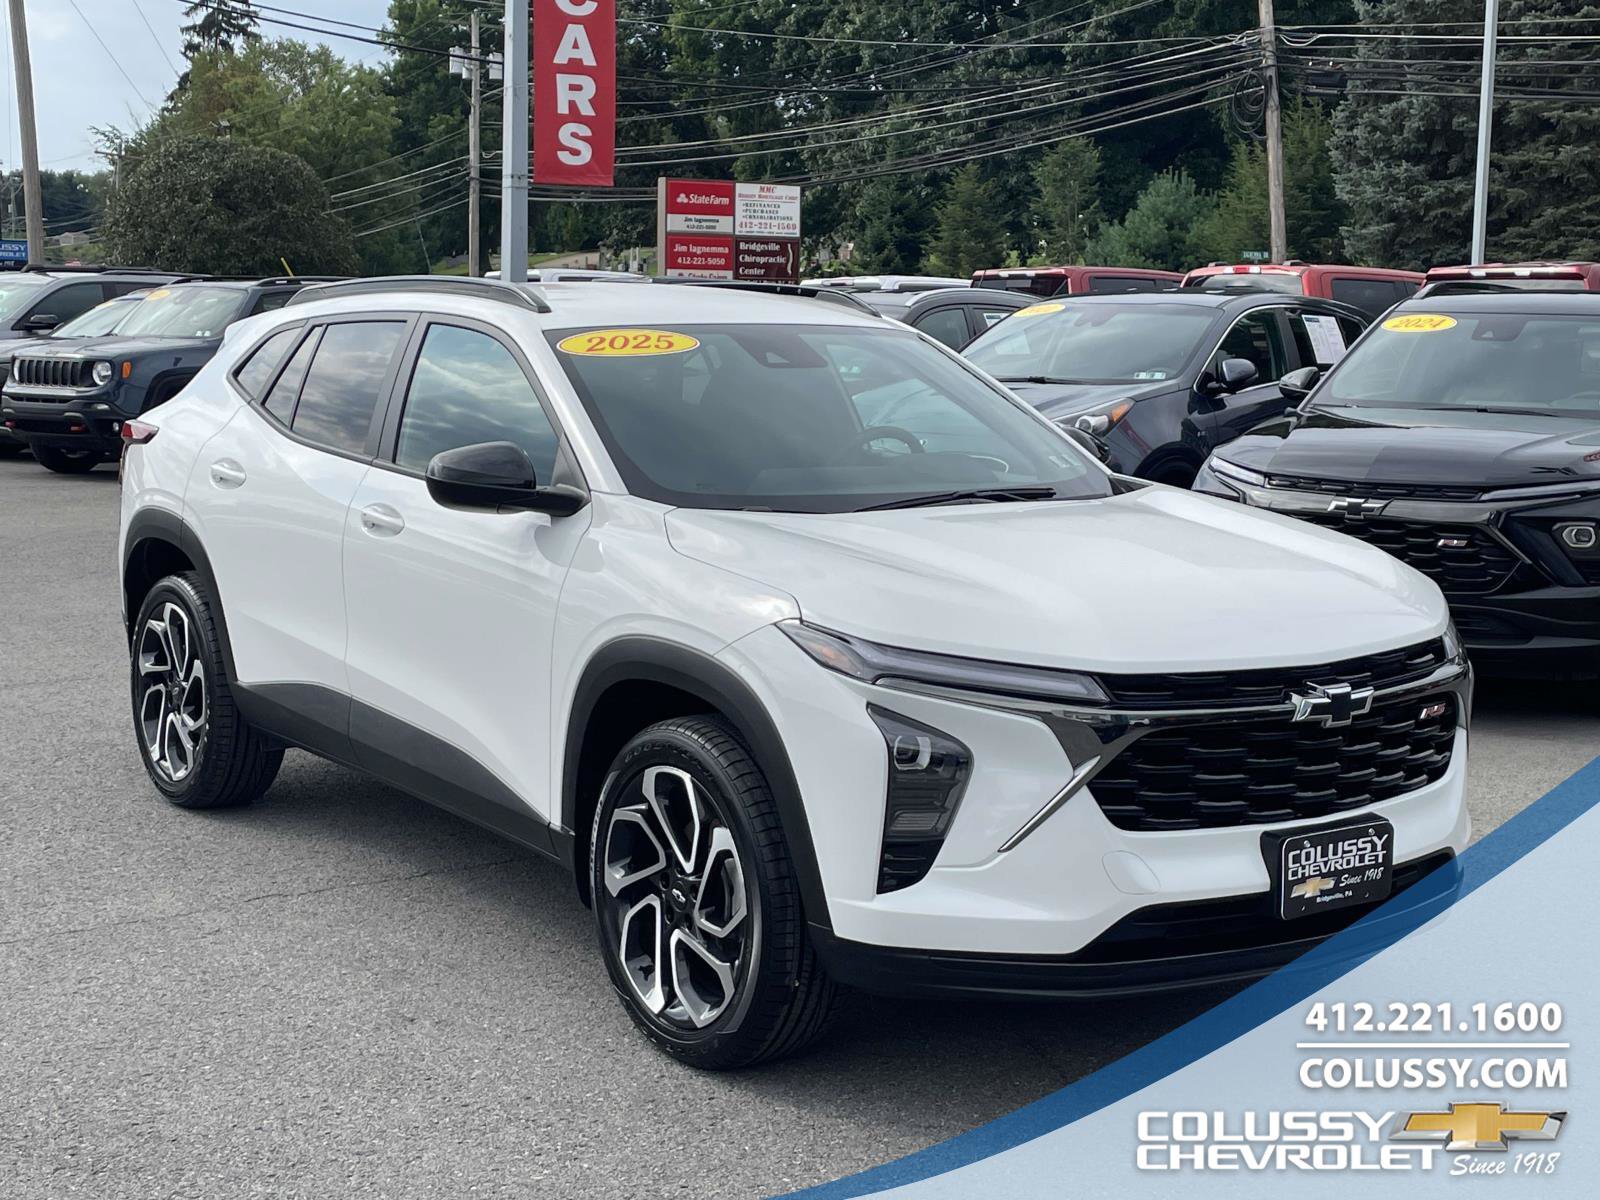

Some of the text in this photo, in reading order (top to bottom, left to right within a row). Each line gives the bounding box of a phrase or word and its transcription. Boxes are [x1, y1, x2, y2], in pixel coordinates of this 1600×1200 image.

[673, 243, 729, 255] Jim Iagnemma
[739, 241, 781, 252] Bridgeville
[677, 256, 726, 265] 412-221-5050
[739, 254, 787, 264] Chiropractic
[739, 267, 766, 276] Center
[1391, 317, 1447, 329] 2024
[585, 334, 674, 353] 2025
[1287, 833, 1389, 869] COLUSSY
[1287, 850, 1387, 881] CHEVROLET
[1339, 867, 1385, 887] Since 1918
[1345, 889, 1353, 897] PA
